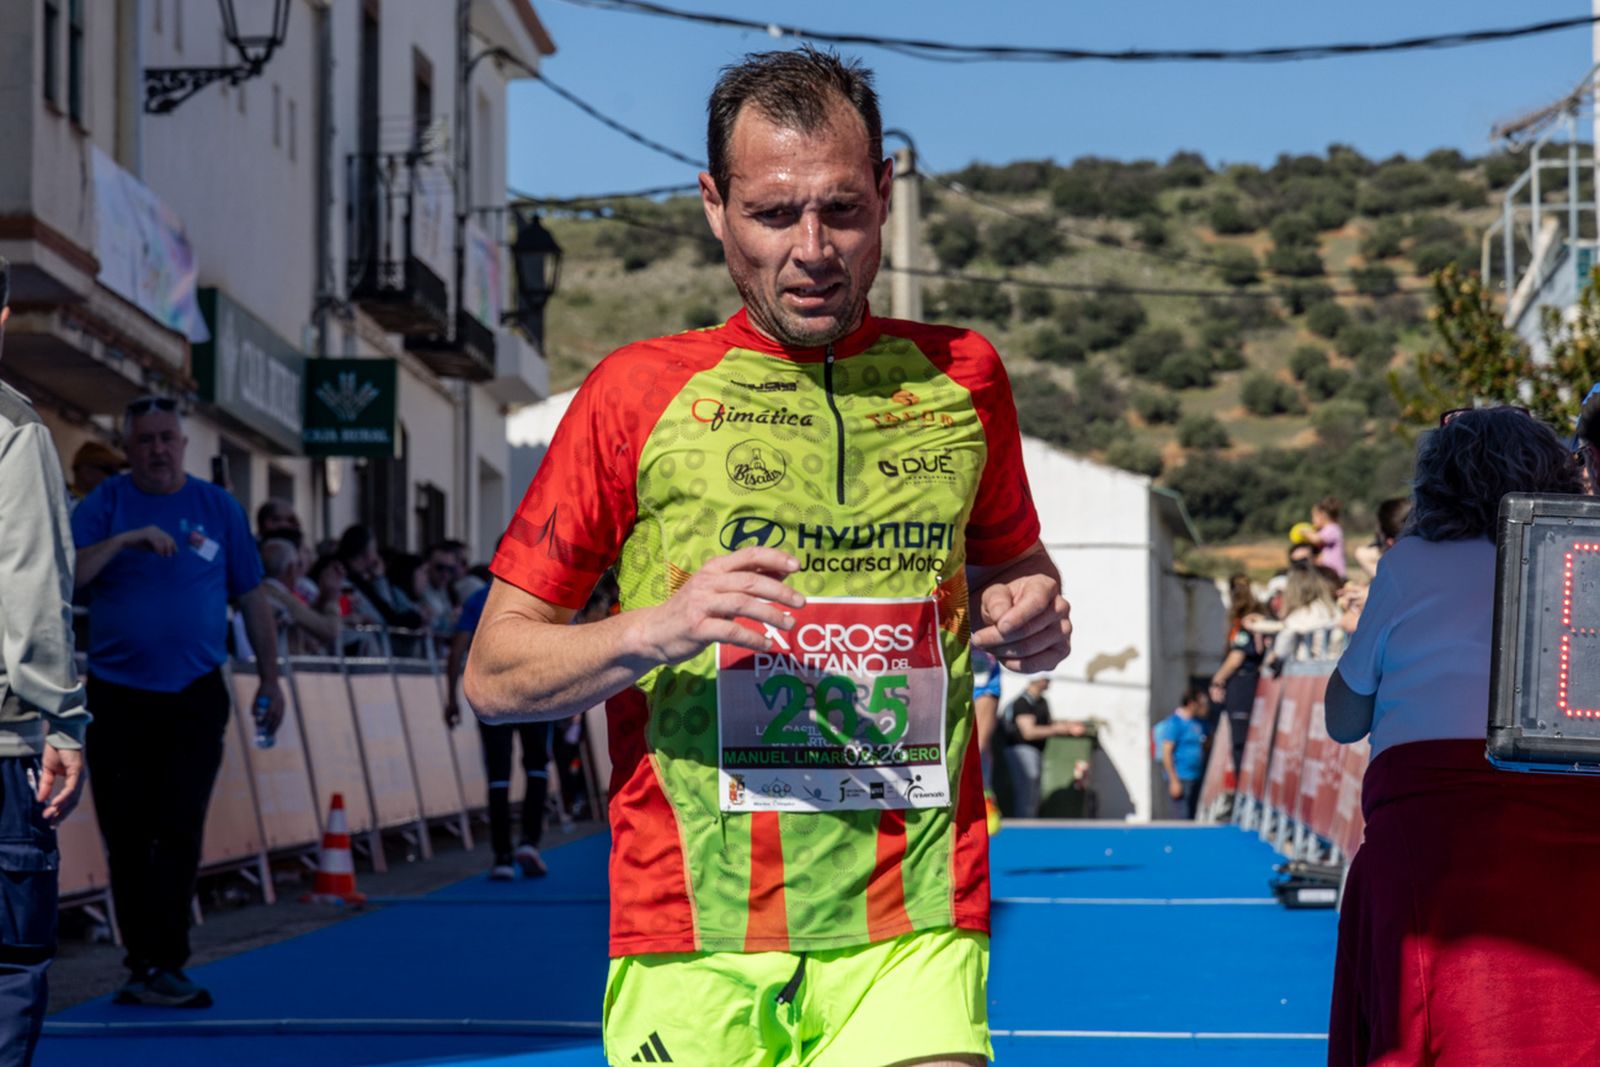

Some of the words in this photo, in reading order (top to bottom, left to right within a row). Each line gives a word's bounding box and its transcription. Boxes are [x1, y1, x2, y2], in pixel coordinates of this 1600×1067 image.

[799, 553, 891, 574] Jacarsa
[797, 623, 915, 652] CROSS
[754, 652, 889, 679] PANTANO
[761, 674, 909, 745] 265
[724, 750, 790, 765] MANUEL
